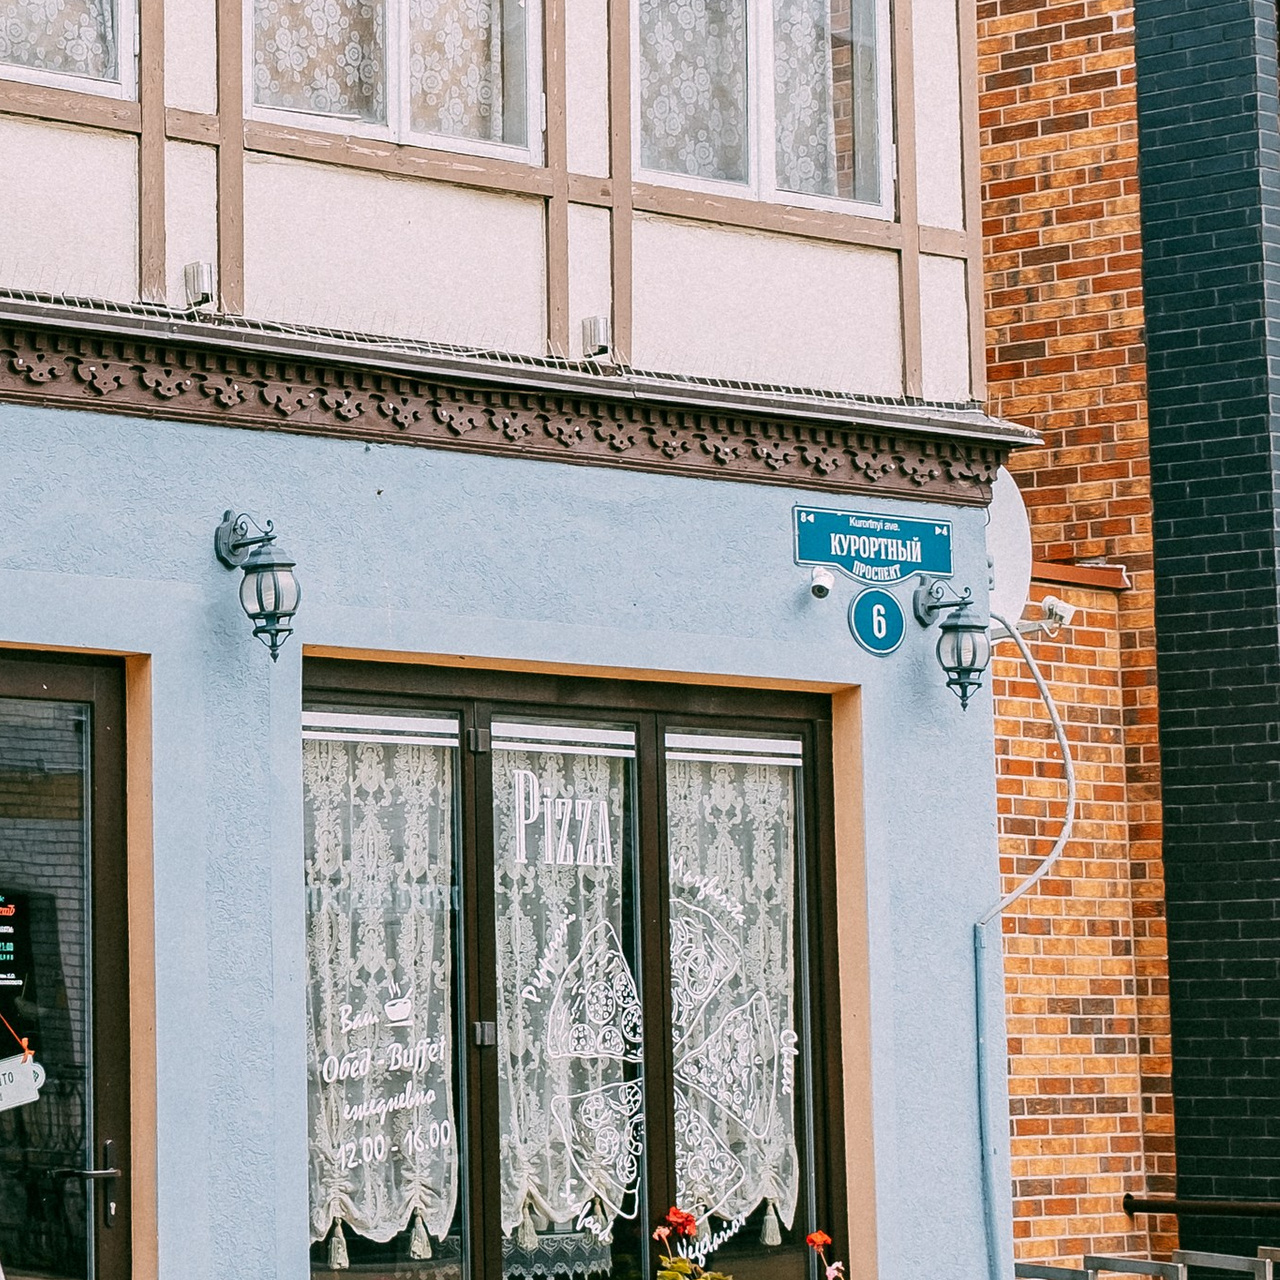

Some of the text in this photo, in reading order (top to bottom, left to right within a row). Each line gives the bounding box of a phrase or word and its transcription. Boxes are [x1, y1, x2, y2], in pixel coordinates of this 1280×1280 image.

[800, 511, 807, 523] 8
[941, 526, 948, 536] 4
[830, 533, 922, 563] КУРОРТНЫЙ
[853, 560, 901, 581] ПРОСПЕКТ
[872, 604, 887, 639] 6
[339, 1004, 380, 1033] Ваш
[322, 1048, 371, 1083] Обед
[387, 1035, 446, 1074] Buffet
[780, 1028, 800, 1096] Cheese
[337, 1134, 386, 1171] 12.00
[404, 1120, 451, 1156] 16.00
